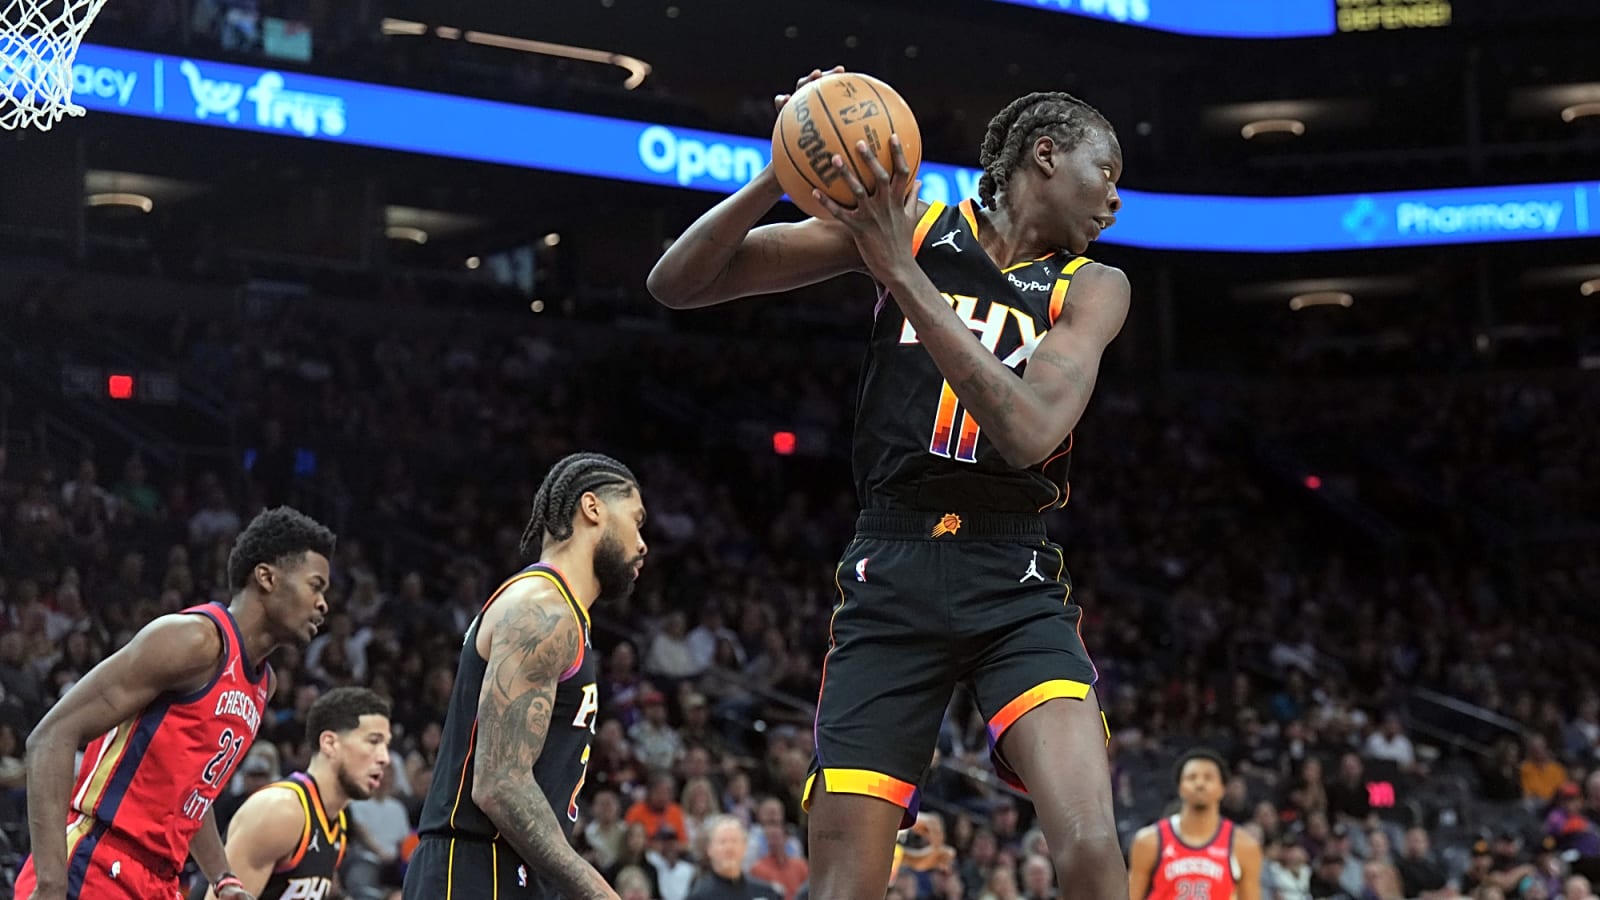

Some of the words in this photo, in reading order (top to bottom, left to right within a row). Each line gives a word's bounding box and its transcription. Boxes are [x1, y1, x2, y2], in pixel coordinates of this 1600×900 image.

[638, 125, 764, 186] Open
[794, 95, 843, 188] Wilson
[1397, 201, 1563, 235] Pharmacy
[1007, 272, 1052, 292] PayPal
[202, 728, 245, 788] 21
[183, 789, 215, 820] CITY
